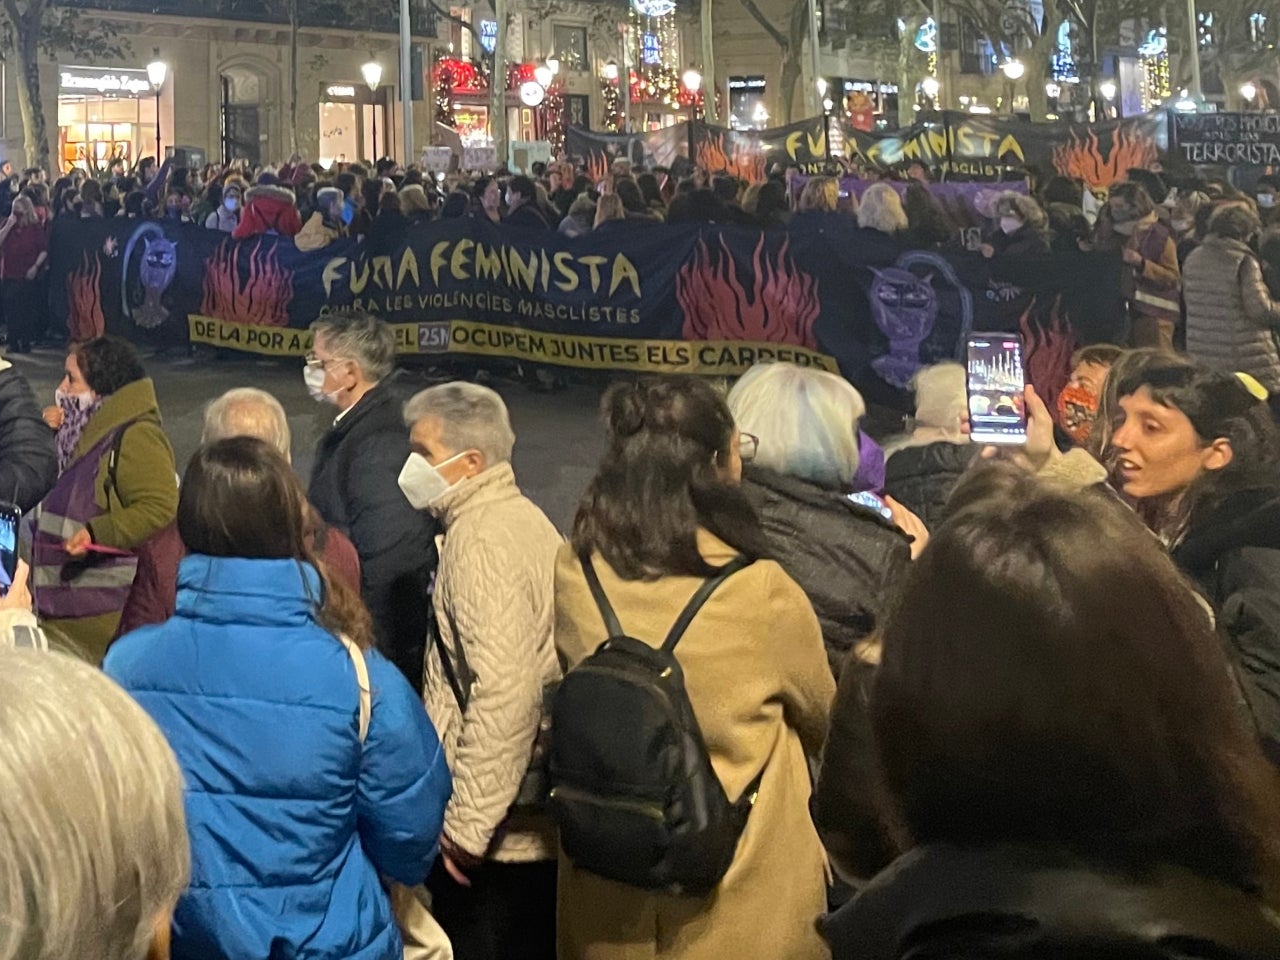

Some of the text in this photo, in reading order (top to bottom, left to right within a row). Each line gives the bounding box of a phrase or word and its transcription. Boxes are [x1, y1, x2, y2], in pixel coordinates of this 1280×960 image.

[867, 125, 1025, 169] FMINISTA
[430, 238, 641, 299] FEMINISTA
[194, 320, 216, 338] DE
[220, 324, 240, 343] LA
[246, 329, 283, 350] POR
[288, 334, 301, 351] A
[452, 326, 547, 354] OCUPEM
[551, 339, 639, 363] JUNTES
[647, 344, 689, 366] ELS
